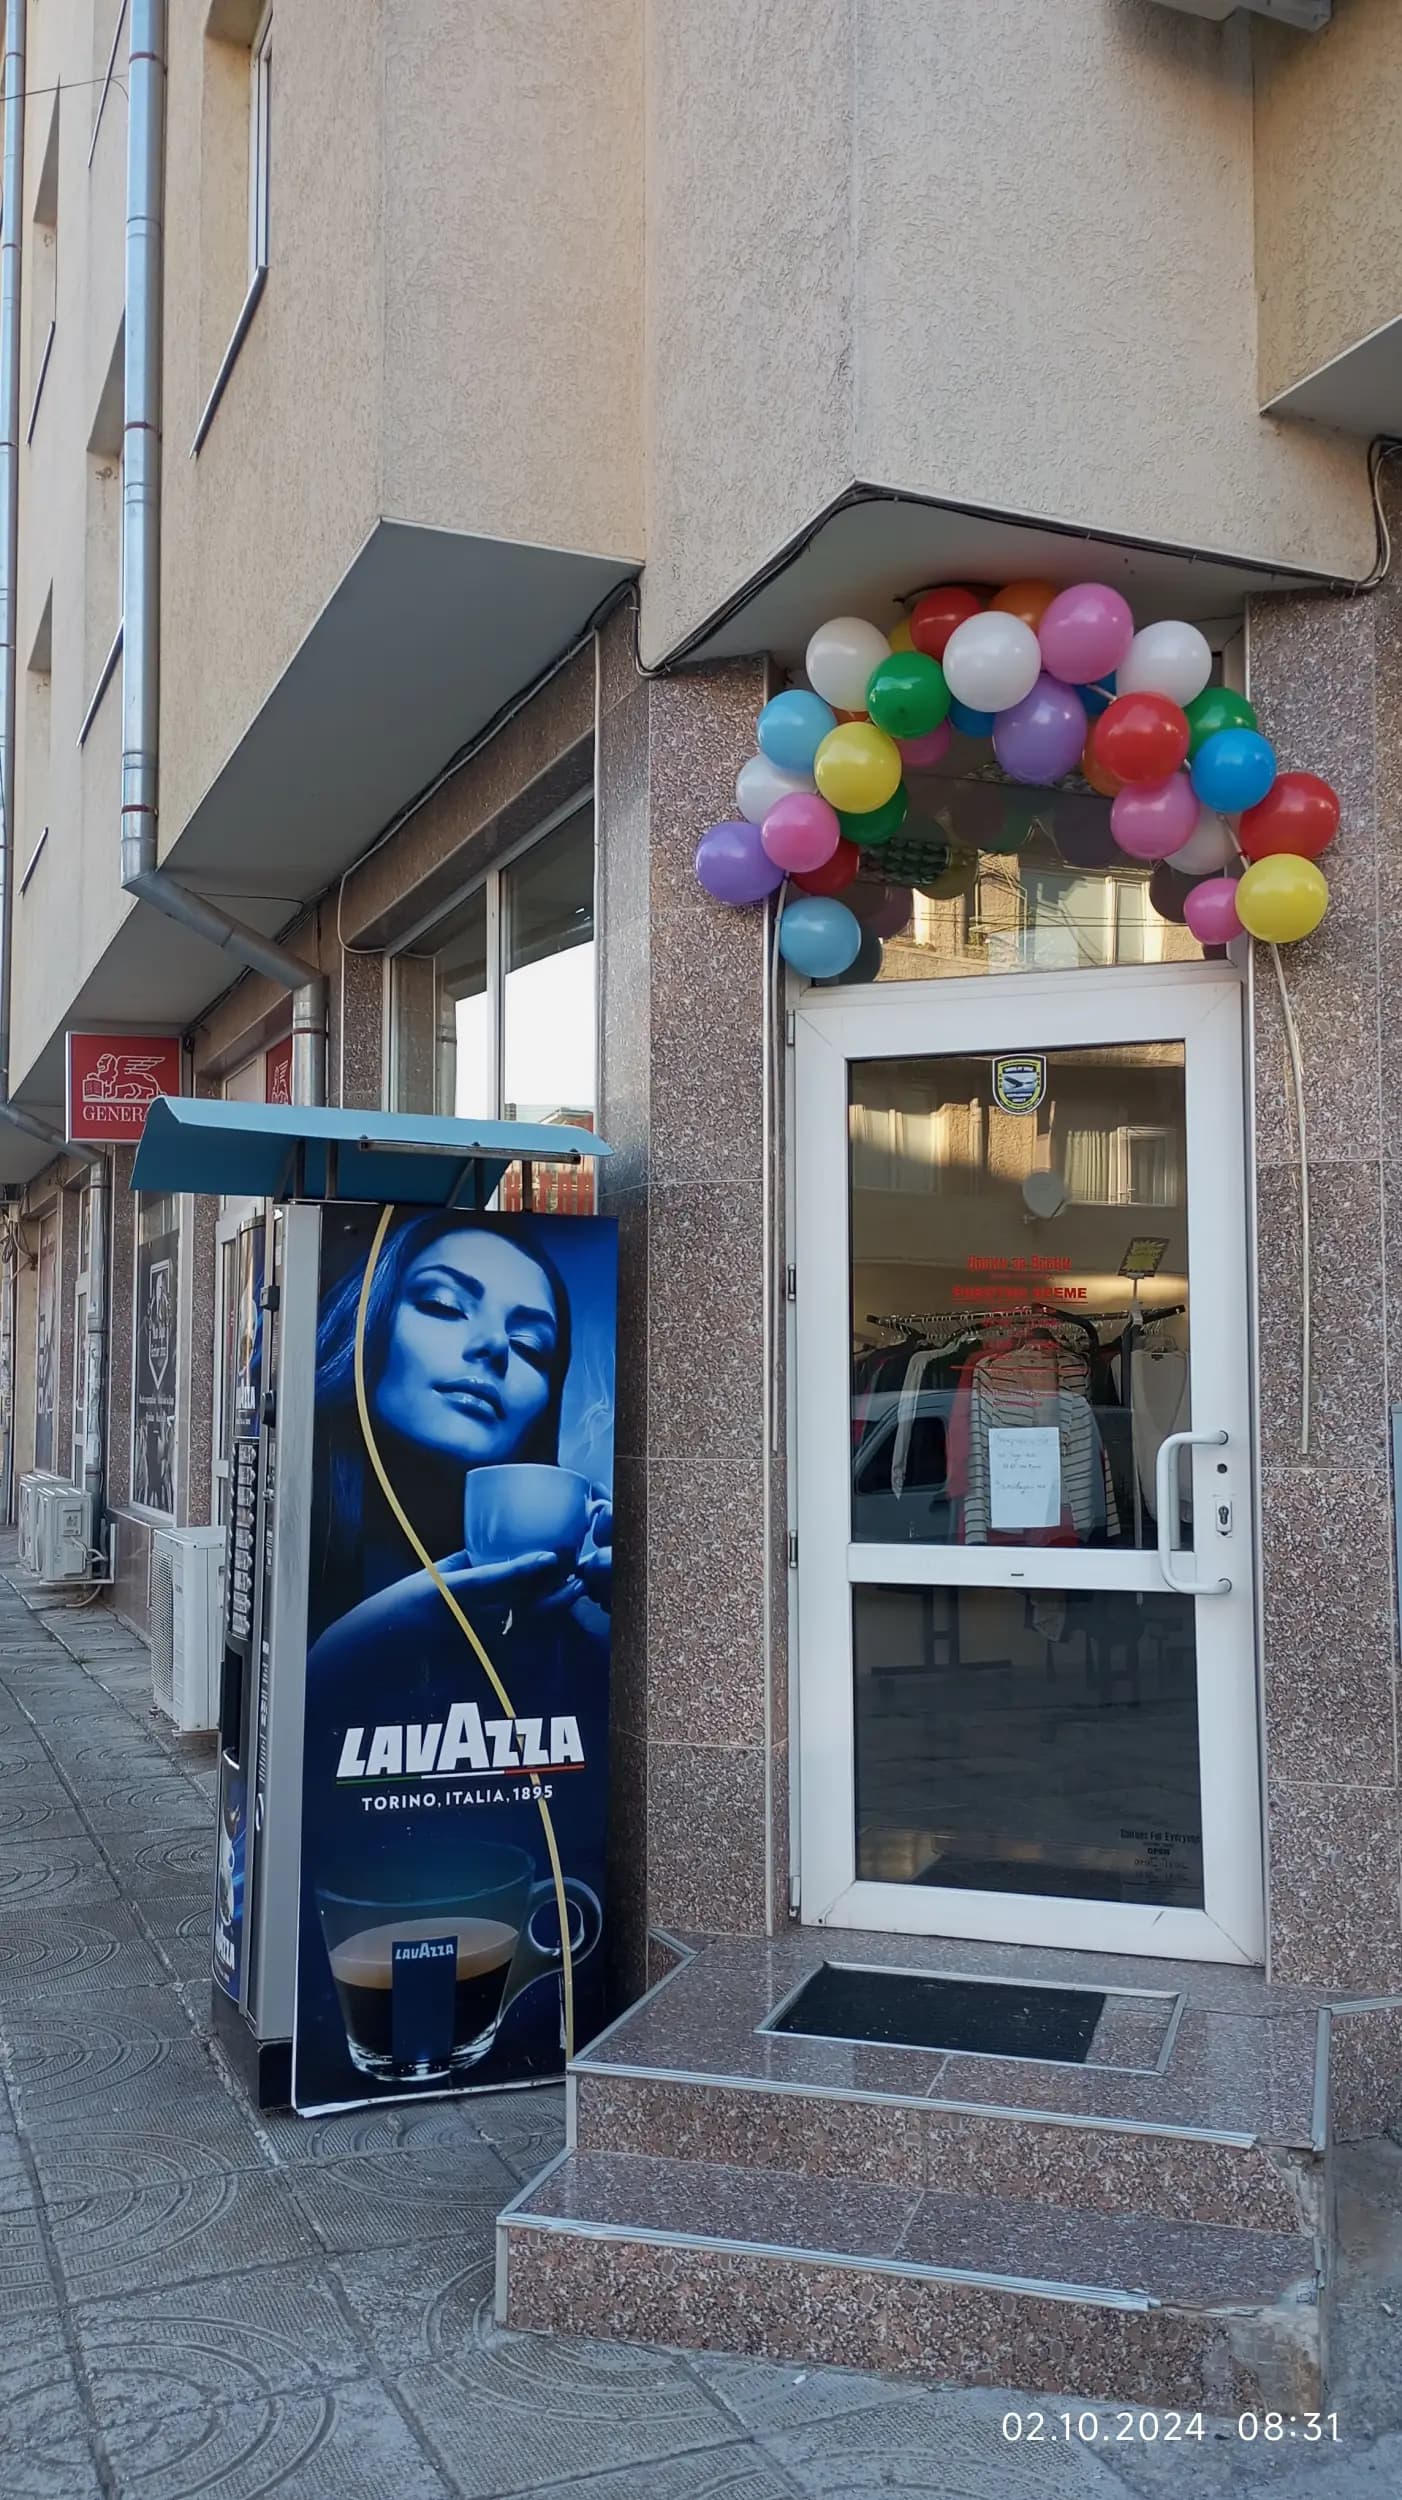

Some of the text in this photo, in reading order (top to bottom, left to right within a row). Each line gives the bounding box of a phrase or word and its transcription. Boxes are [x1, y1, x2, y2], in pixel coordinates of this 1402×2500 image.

[82, 1105, 146, 1122] GENER
[336, 1702, 585, 1777] LAVAZZA
[361, 1785, 553, 1811] TORINO, ITALIA, 1895
[395, 1943, 455, 1960] LAVAZZA
